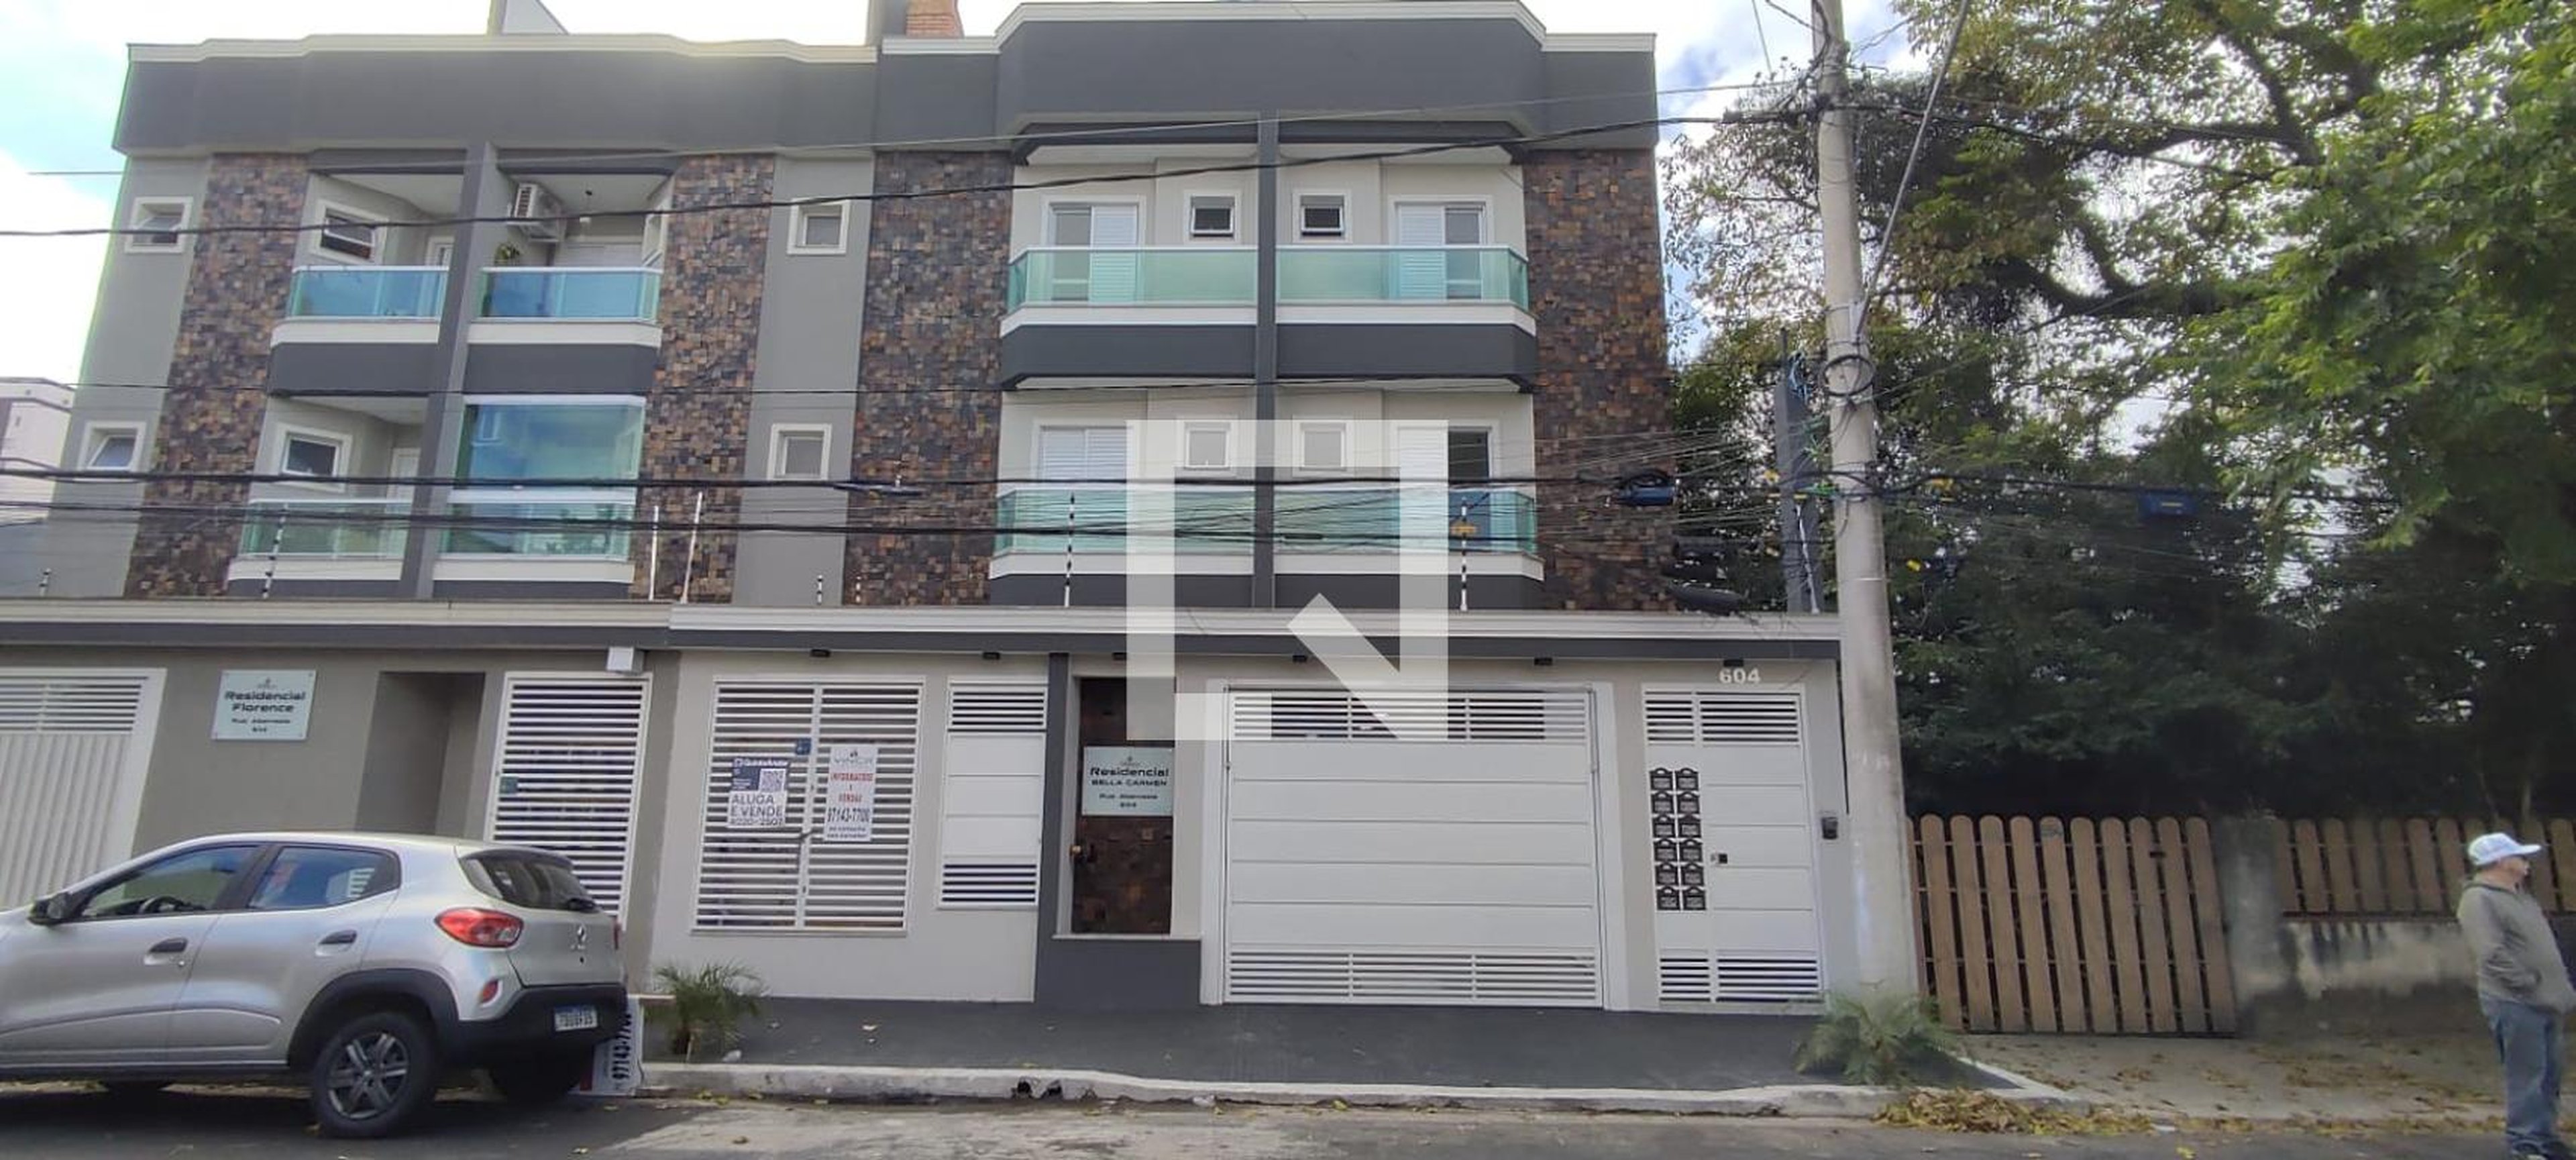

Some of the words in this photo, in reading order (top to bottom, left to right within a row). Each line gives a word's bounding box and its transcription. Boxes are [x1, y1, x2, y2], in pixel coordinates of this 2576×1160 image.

[1720, 667, 1762, 684] 604
[225, 690, 306, 701] Residencial
[232, 702, 294, 713] Florence
[1089, 766, 1169, 777] Residencial
[731, 794, 774, 805] ALUGA
[730, 805, 737, 816] E
[740, 805, 784, 817] VENDE
